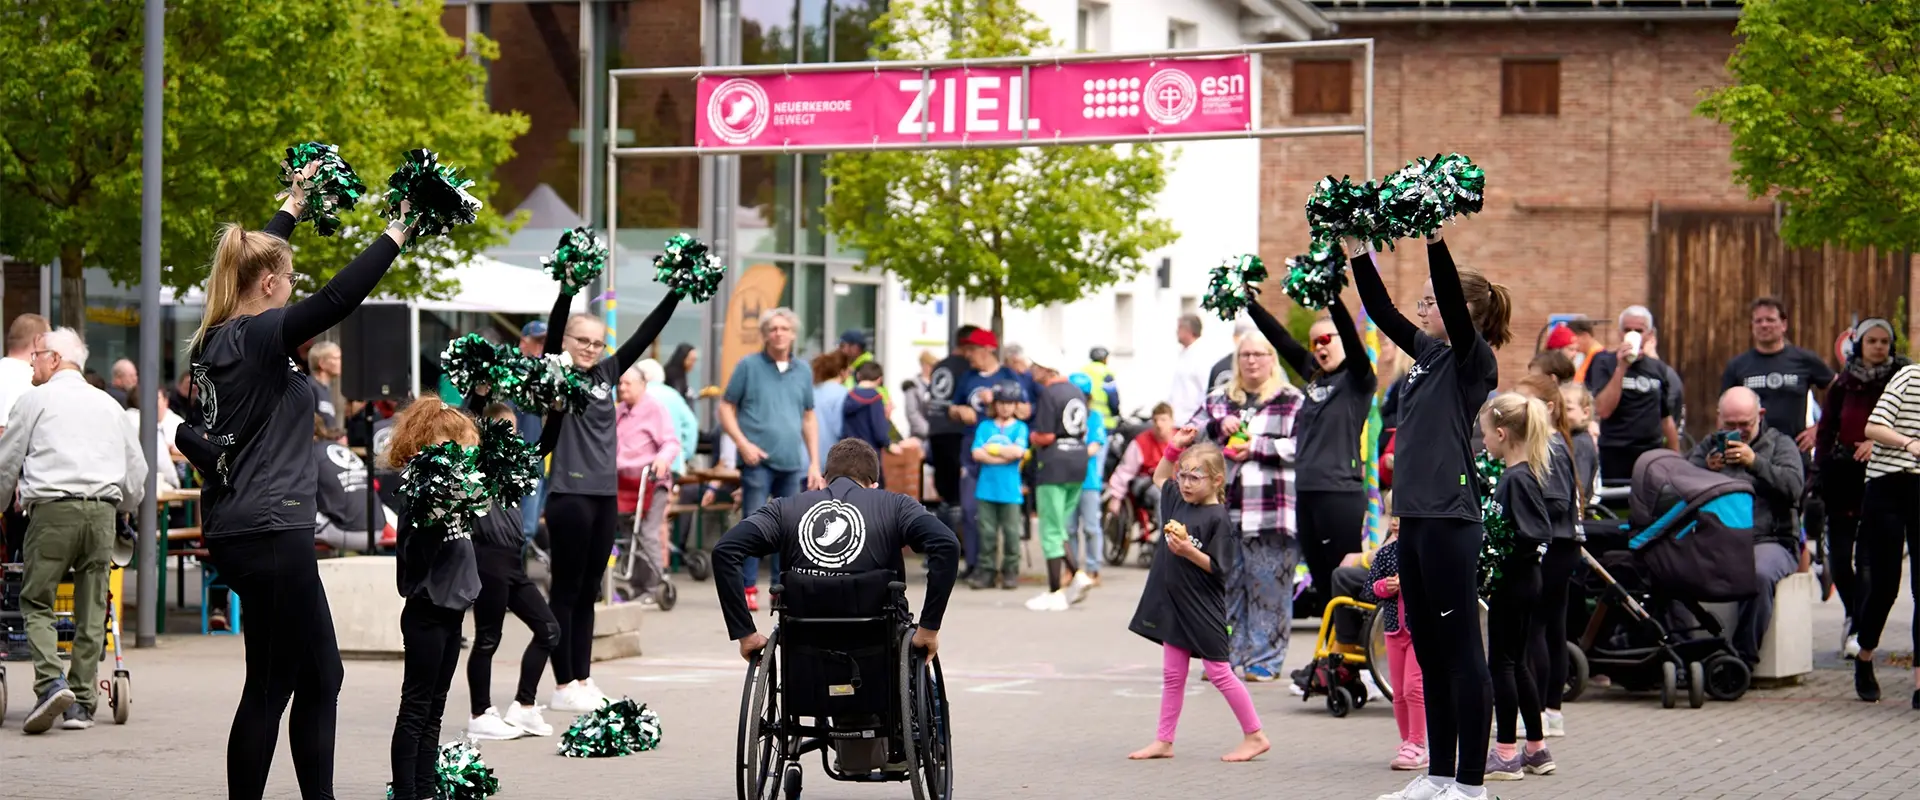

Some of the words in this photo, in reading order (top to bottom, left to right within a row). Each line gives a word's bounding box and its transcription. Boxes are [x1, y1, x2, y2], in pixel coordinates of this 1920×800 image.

[1200, 74, 1245, 97] esn
[773, 99, 852, 114] NEUERKERODE
[897, 75, 1041, 134] ZIEL
[773, 113, 816, 126] BEWEGT
